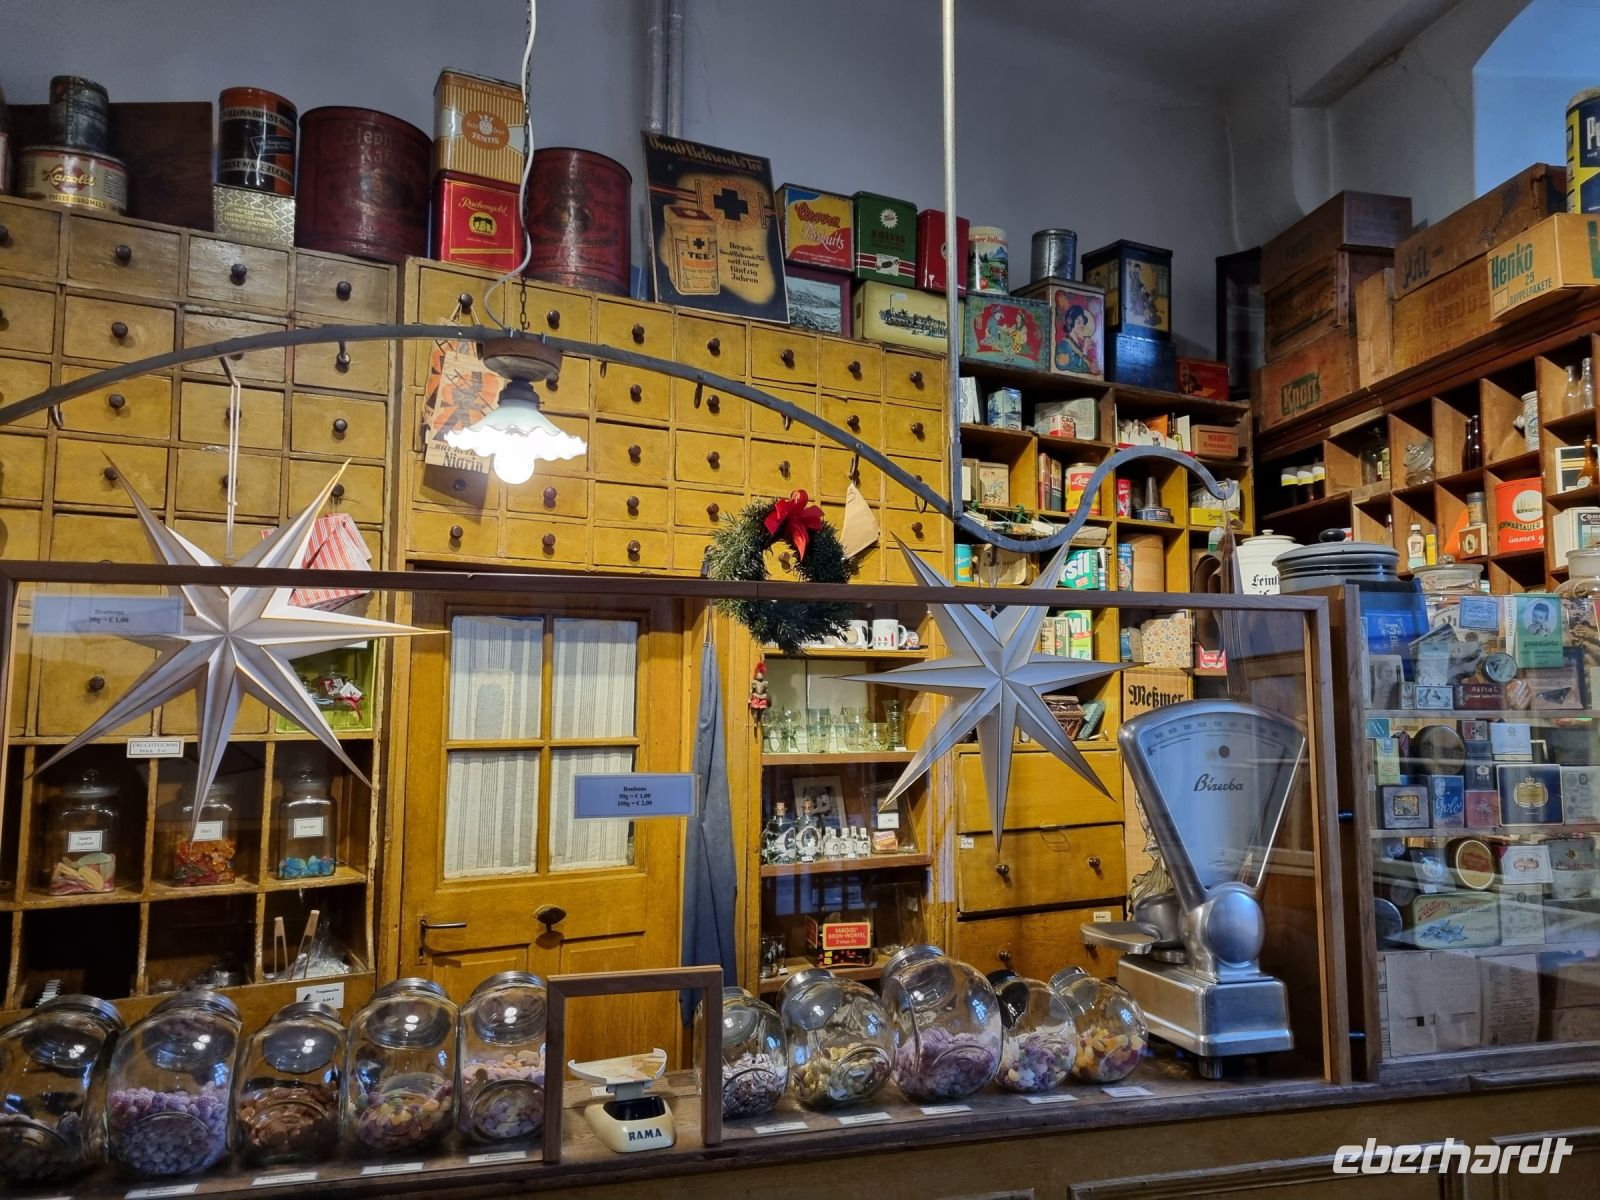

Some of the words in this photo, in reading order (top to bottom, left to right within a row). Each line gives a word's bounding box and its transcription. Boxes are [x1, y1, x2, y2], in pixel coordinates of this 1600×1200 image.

[472, 132, 500, 144] ZENTIS
[688, 251, 710, 260] TEE
[1491, 243, 1533, 290] Henko
[731, 273, 759, 284] Jahren
[1525, 271, 1535, 286] 25
[1128, 684, 1185, 709] Meßmer
[1193, 773, 1244, 792] Bizerba
[628, 1127, 663, 1142] RAMA
